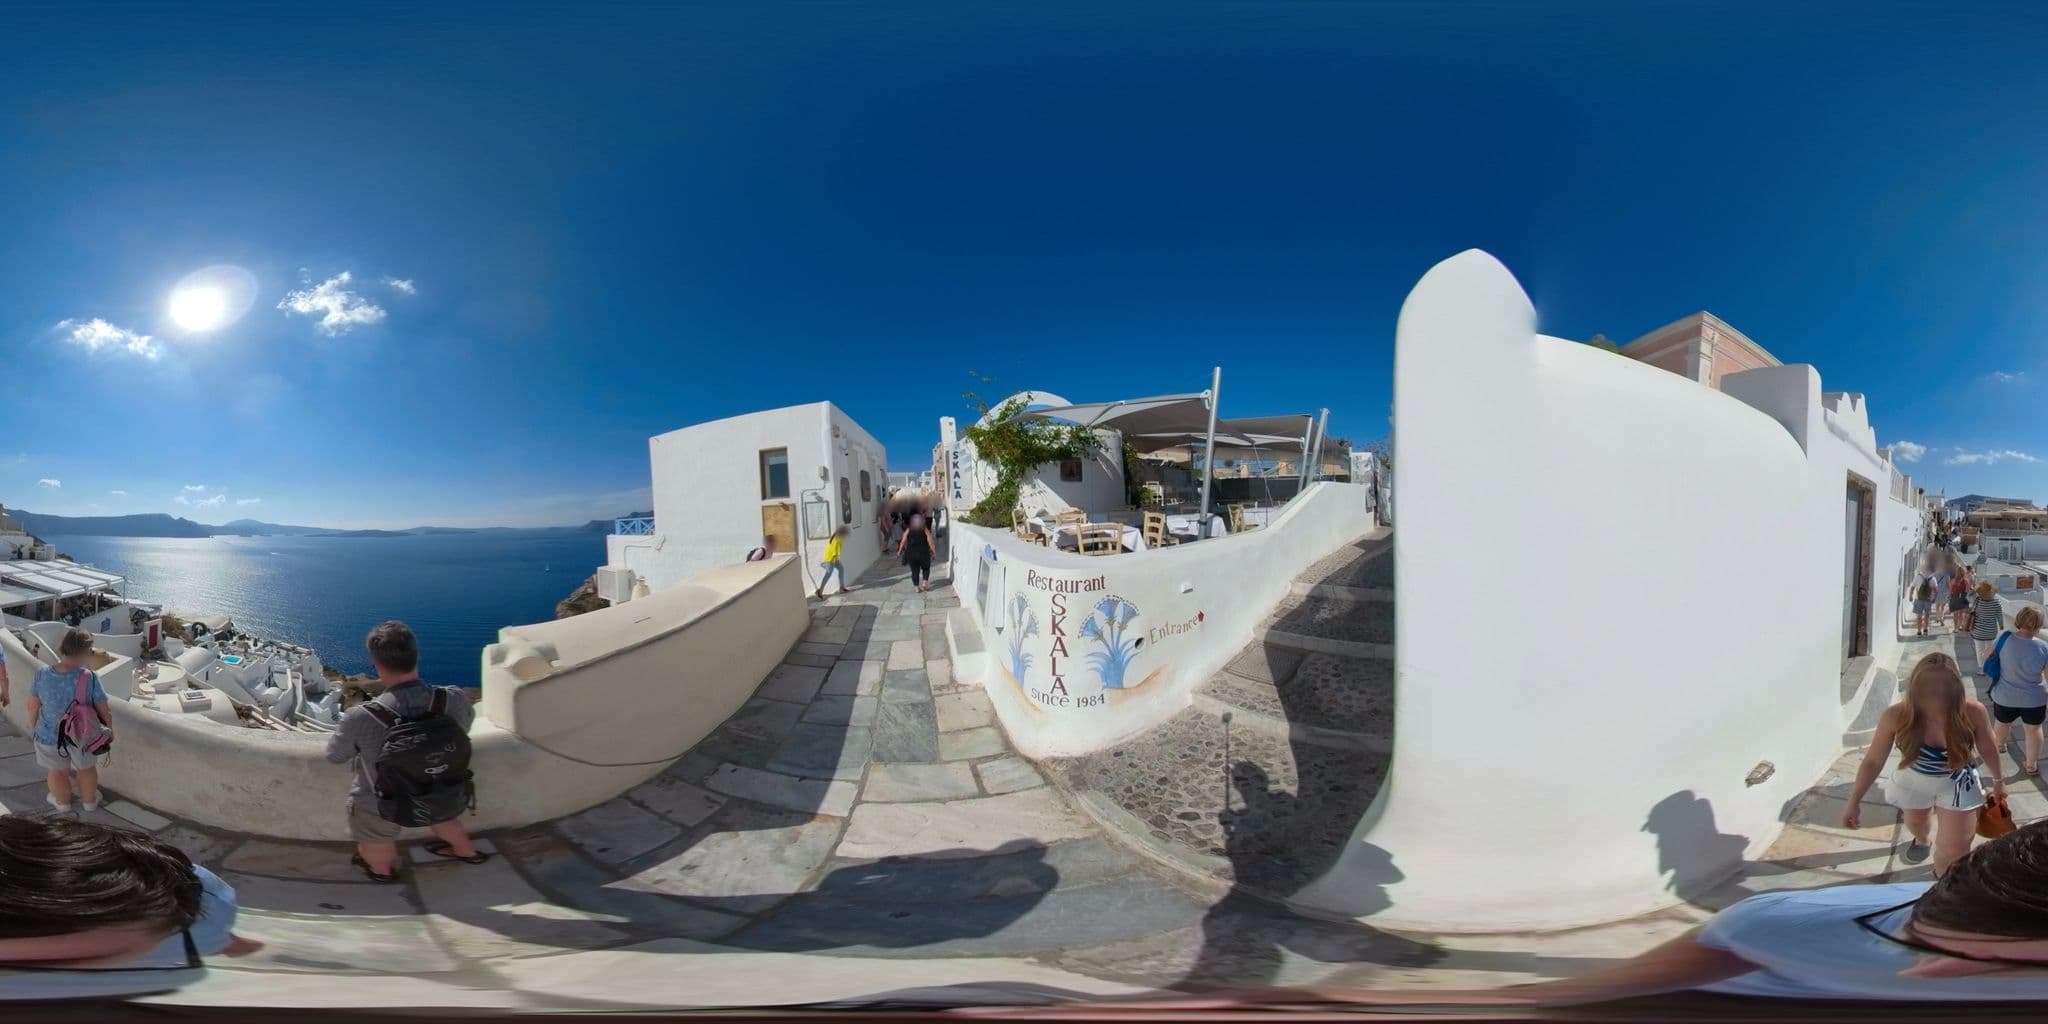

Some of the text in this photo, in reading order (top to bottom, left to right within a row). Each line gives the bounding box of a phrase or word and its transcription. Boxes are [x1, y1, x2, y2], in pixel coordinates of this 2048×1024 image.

[952, 451, 962, 499] SKALA
[1027, 570, 1106, 594] Restaurant
[1050, 593, 1069, 695] SKALA
[1150, 615, 1198, 645] Entrance
[1031, 687, 1105, 709] since 1984
